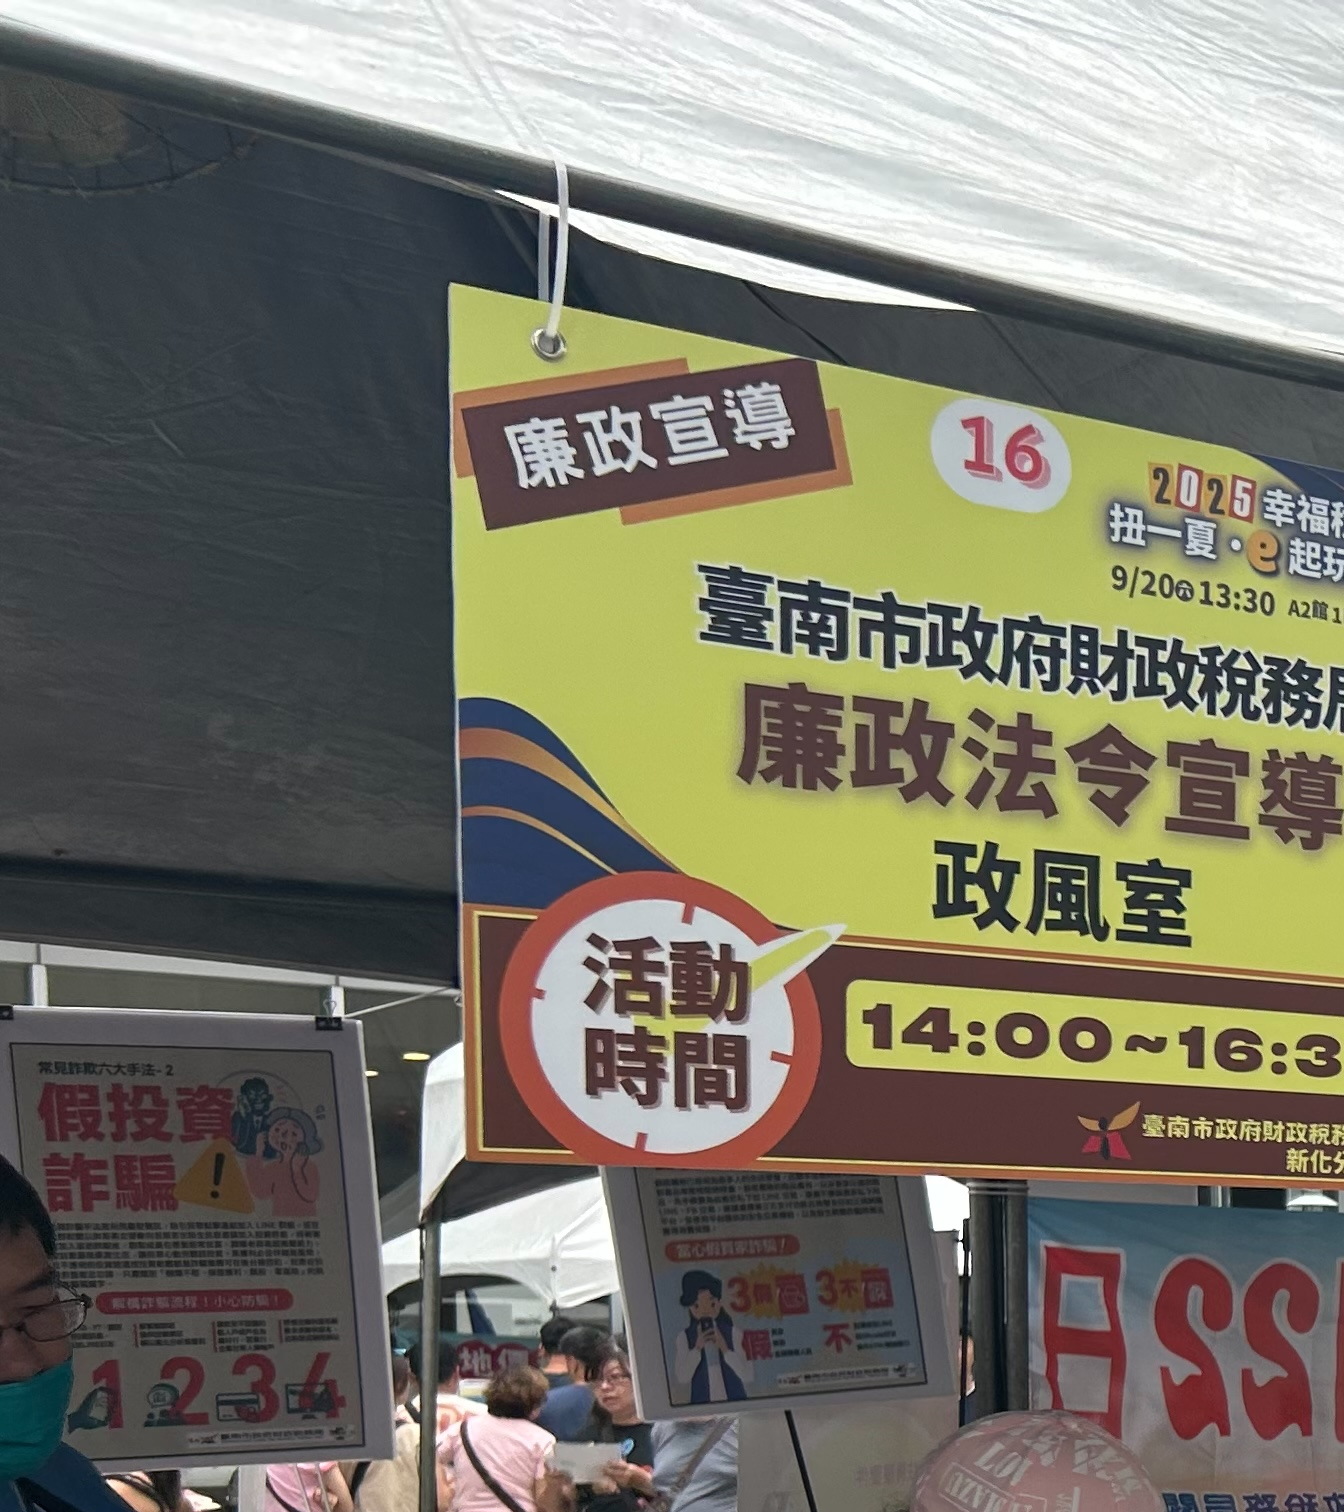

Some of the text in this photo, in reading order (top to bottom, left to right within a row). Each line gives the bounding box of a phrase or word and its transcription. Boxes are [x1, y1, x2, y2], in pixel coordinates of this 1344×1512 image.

[503, 382, 797, 490] 廉政宣導
[960, 416, 1053, 489] 16
[932, 839, 1194, 948] 政風室
[581, 932, 752, 1025] 活動
[583, 1026, 748, 1112] 時間
[37, 1082, 236, 1143] 假投資
[42, 1151, 180, 1214] 詐騙
[149, 1356, 210, 1426] 2
[231, 1353, 280, 1424] 3
[304, 1352, 347, 1419] 4
